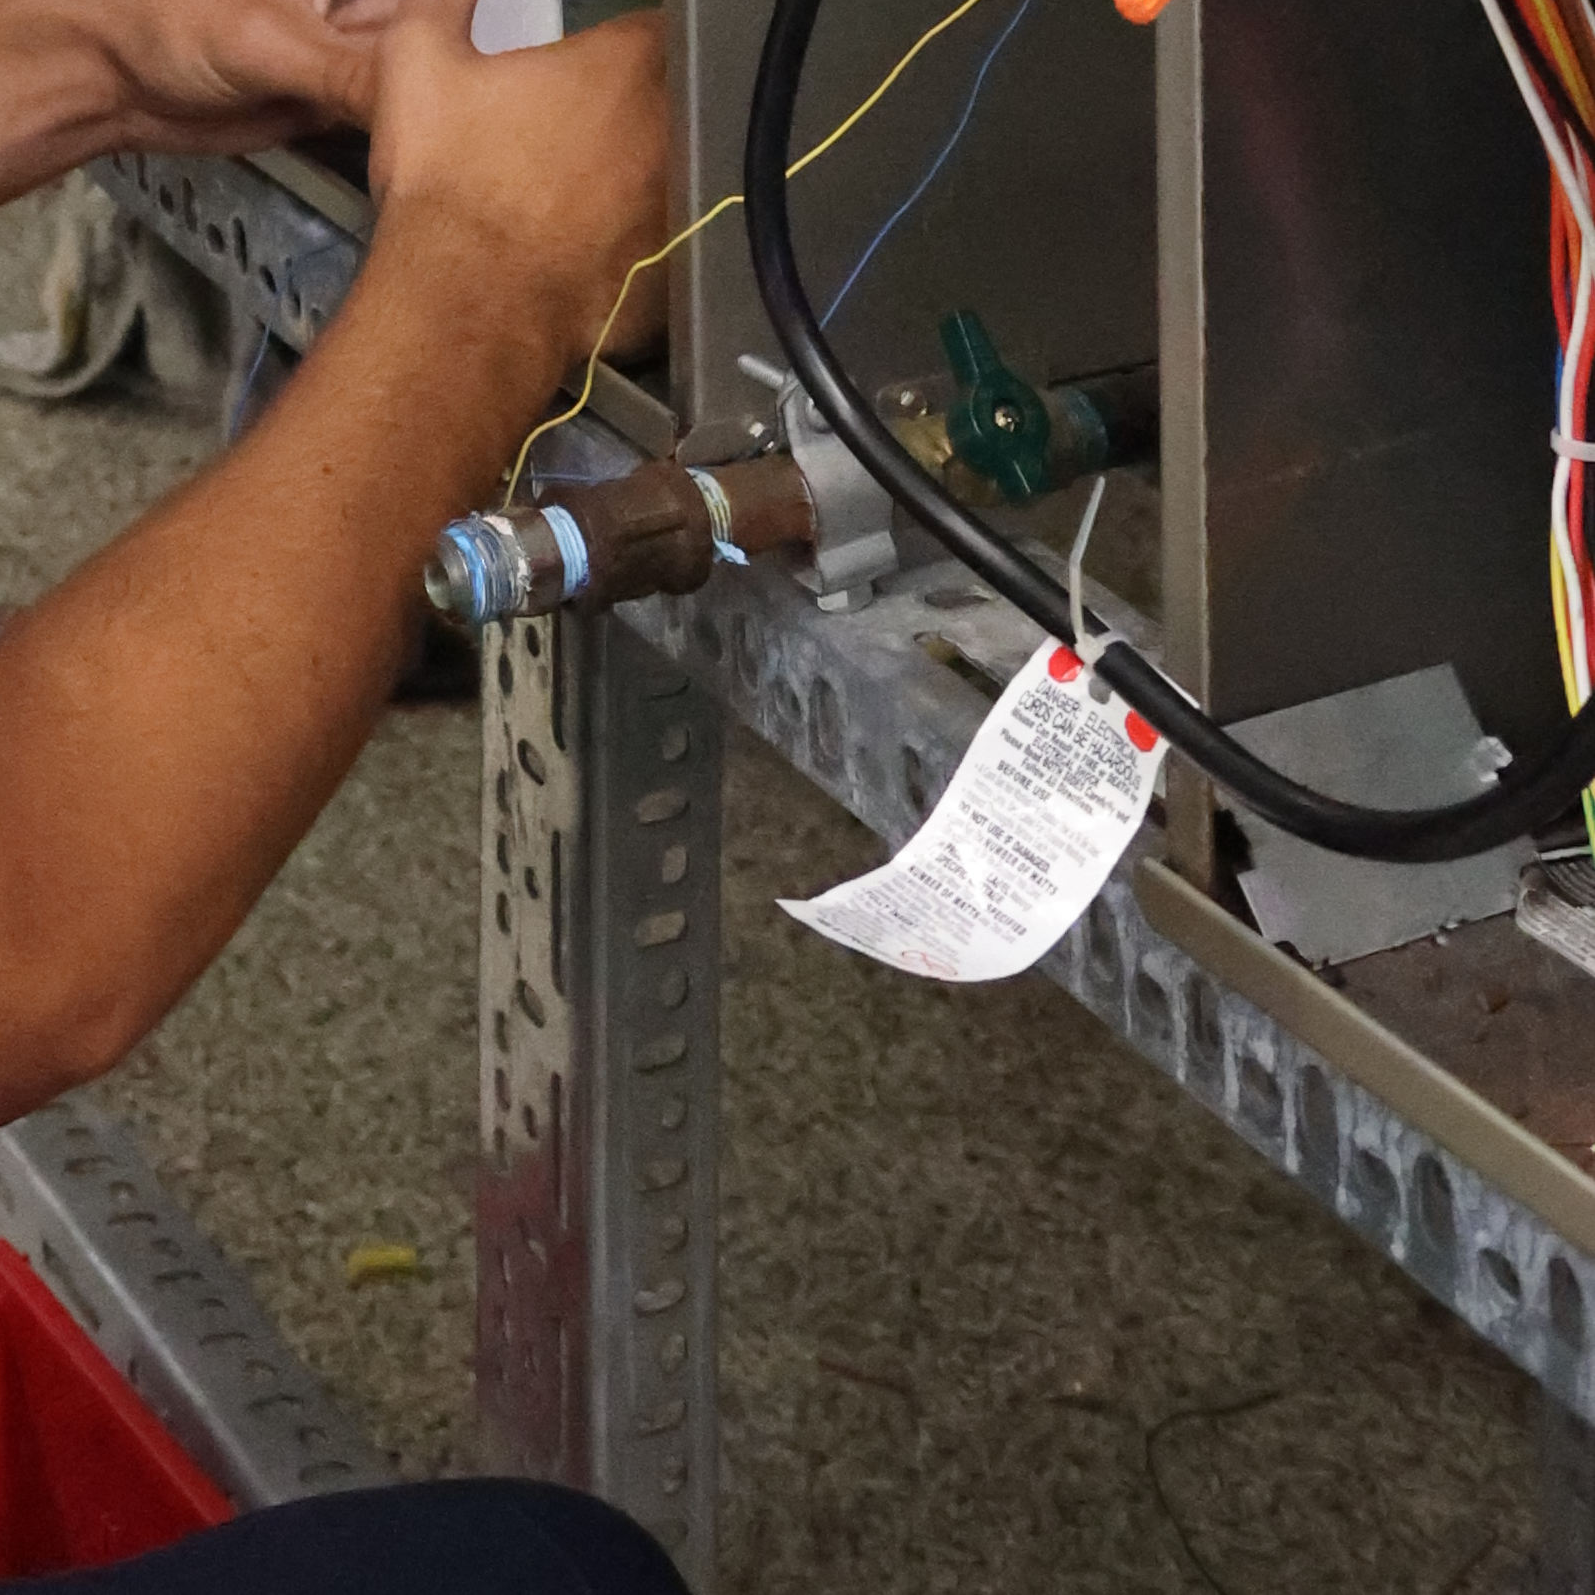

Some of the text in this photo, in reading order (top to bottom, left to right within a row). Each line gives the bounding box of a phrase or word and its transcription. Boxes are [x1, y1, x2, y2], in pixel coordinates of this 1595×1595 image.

[1017, 689, 1056, 724] CORDS
[1050, 712, 1078, 738] CAN
[1071, 726, 1093, 749] BE
[1034, 678, 1145, 768] DANGER: ELECTRICAL
[1031, 735, 1077, 772] ELECTRICAL
[995, 759, 1034, 791] BEFORE
[968, 809, 989, 828] NOT
[985, 821, 1006, 840] USE
[982, 837, 1019, 867] NUMBER
[1016, 861, 1031, 876] OF
[1028, 870, 1059, 897] WATTS
[940, 886, 954, 901] OF
[951, 894, 982, 920] WATTS
[983, 902, 1028, 938] SPECIFIED
